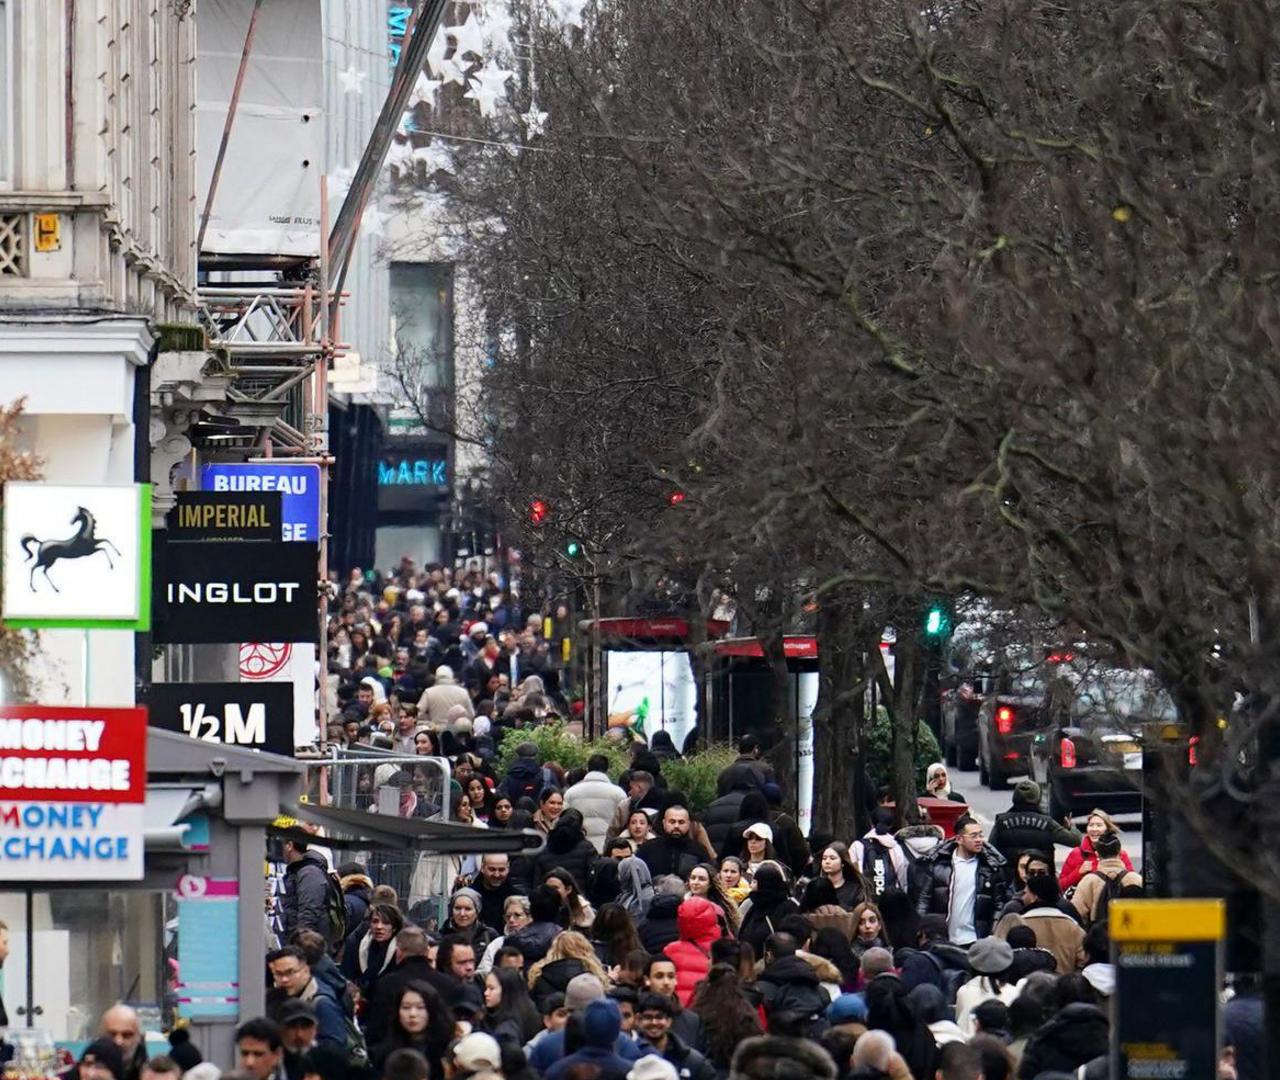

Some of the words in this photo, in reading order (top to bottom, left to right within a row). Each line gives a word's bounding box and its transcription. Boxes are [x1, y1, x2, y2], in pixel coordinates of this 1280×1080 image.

[213, 475, 307, 495] BUREAU
[178, 504, 271, 528] IMPERIAL
[167, 582, 301, 603] INGLOT
